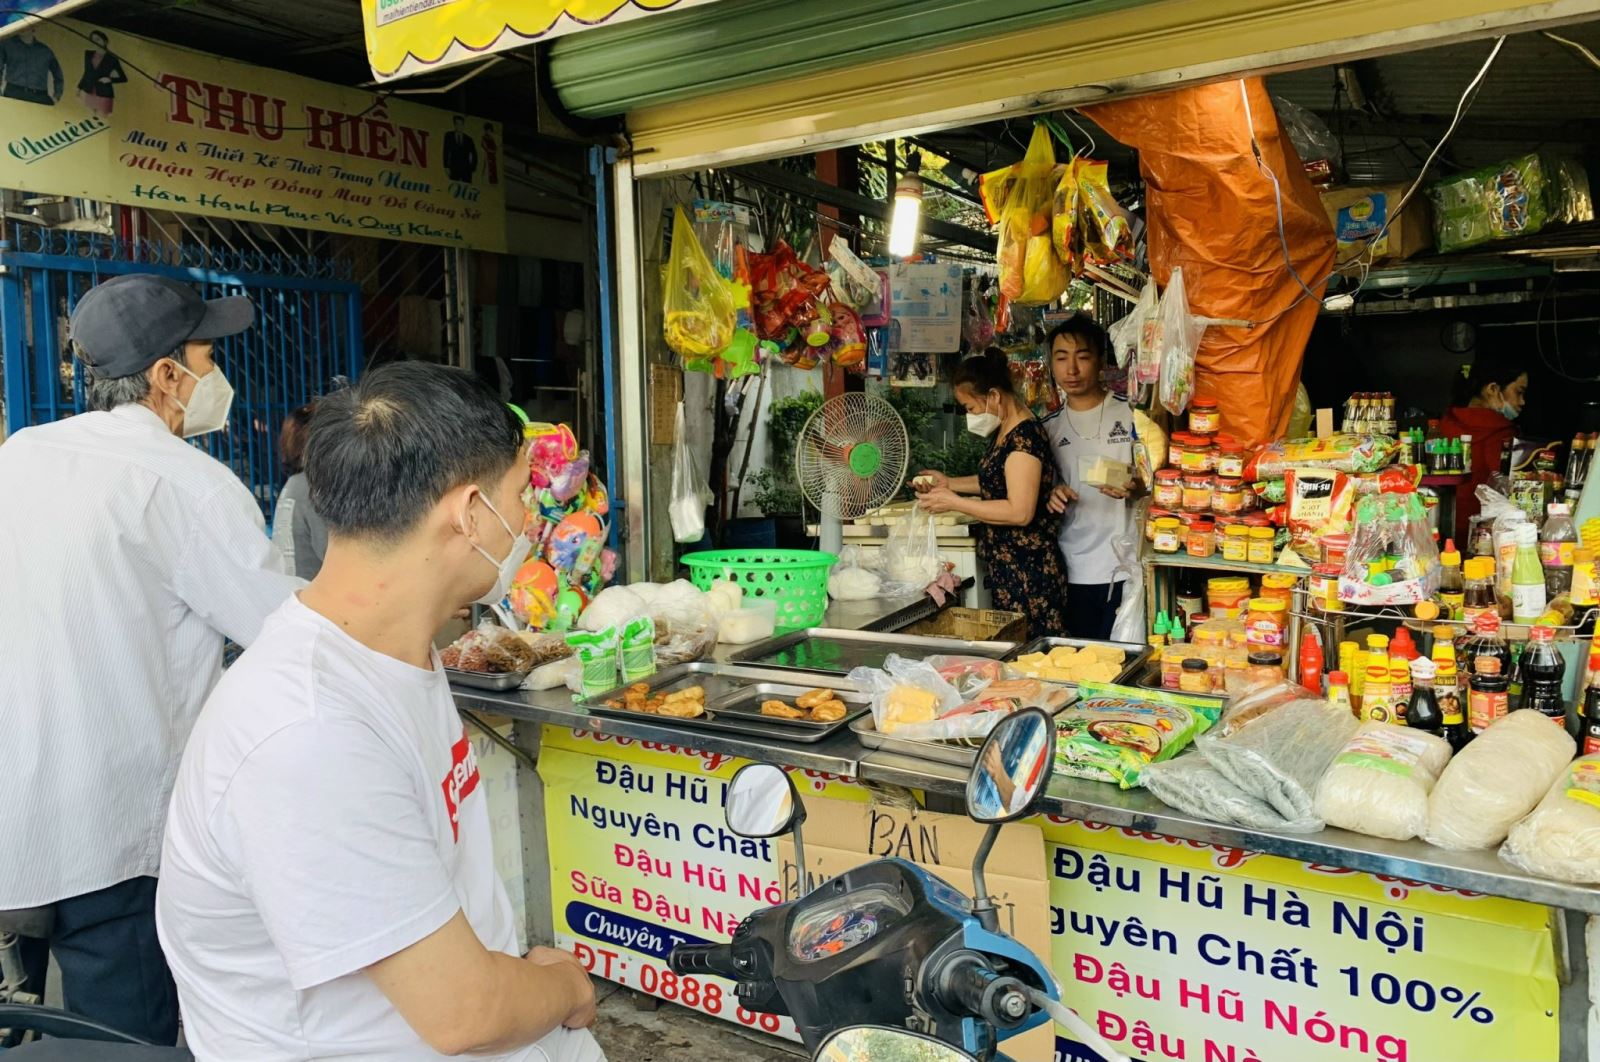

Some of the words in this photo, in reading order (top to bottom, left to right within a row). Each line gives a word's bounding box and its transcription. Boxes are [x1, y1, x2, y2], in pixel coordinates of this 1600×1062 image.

[161, 73, 287, 141] THU
[305, 96, 430, 168] HIỀN
[120, 152, 193, 178] Nhận
[204, 166, 256, 189] Hợp
[329, 187, 372, 206] May
[122, 130, 168, 152] May
[175, 141, 188, 153] &
[196, 142, 245, 162] Thiết
[328, 165, 374, 187] Trang
[378, 169, 432, 194] Nam
[196, 193, 261, 213] Hạnh
[408, 222, 463, 241] Khách
[596, 760, 654, 794] Đậu
[665, 772, 708, 804] Hũ
[570, 794, 681, 841] Nguyên
[571, 869, 622, 905] Sữa
[632, 888, 691, 925] Đậu
[702, 907, 742, 938] Nà
[614, 843, 672, 878] Đậu
[683, 860, 726, 893] Hũ
[738, 873, 783, 906] Nó
[1053, 847, 1140, 892] Đậu
[1160, 867, 1223, 910] Hũ
[1243, 883, 1311, 929] Hà
[1333, 901, 1426, 954] Nội
[584, 911, 664, 952] Chuyên
[574, 942, 627, 984] ĐT:
[639, 963, 723, 1015] 0888
[1050, 905, 1178, 955] guyên
[1197, 933, 1319, 989] Chất
[1340, 966, 1495, 1025] 100%
[1073, 953, 1160, 1001] Đậu
[1180, 979, 1244, 1023] Hũ
[1265, 1001, 1408, 1062] Nóng
[1096, 1010, 1185, 1060] Đậu
